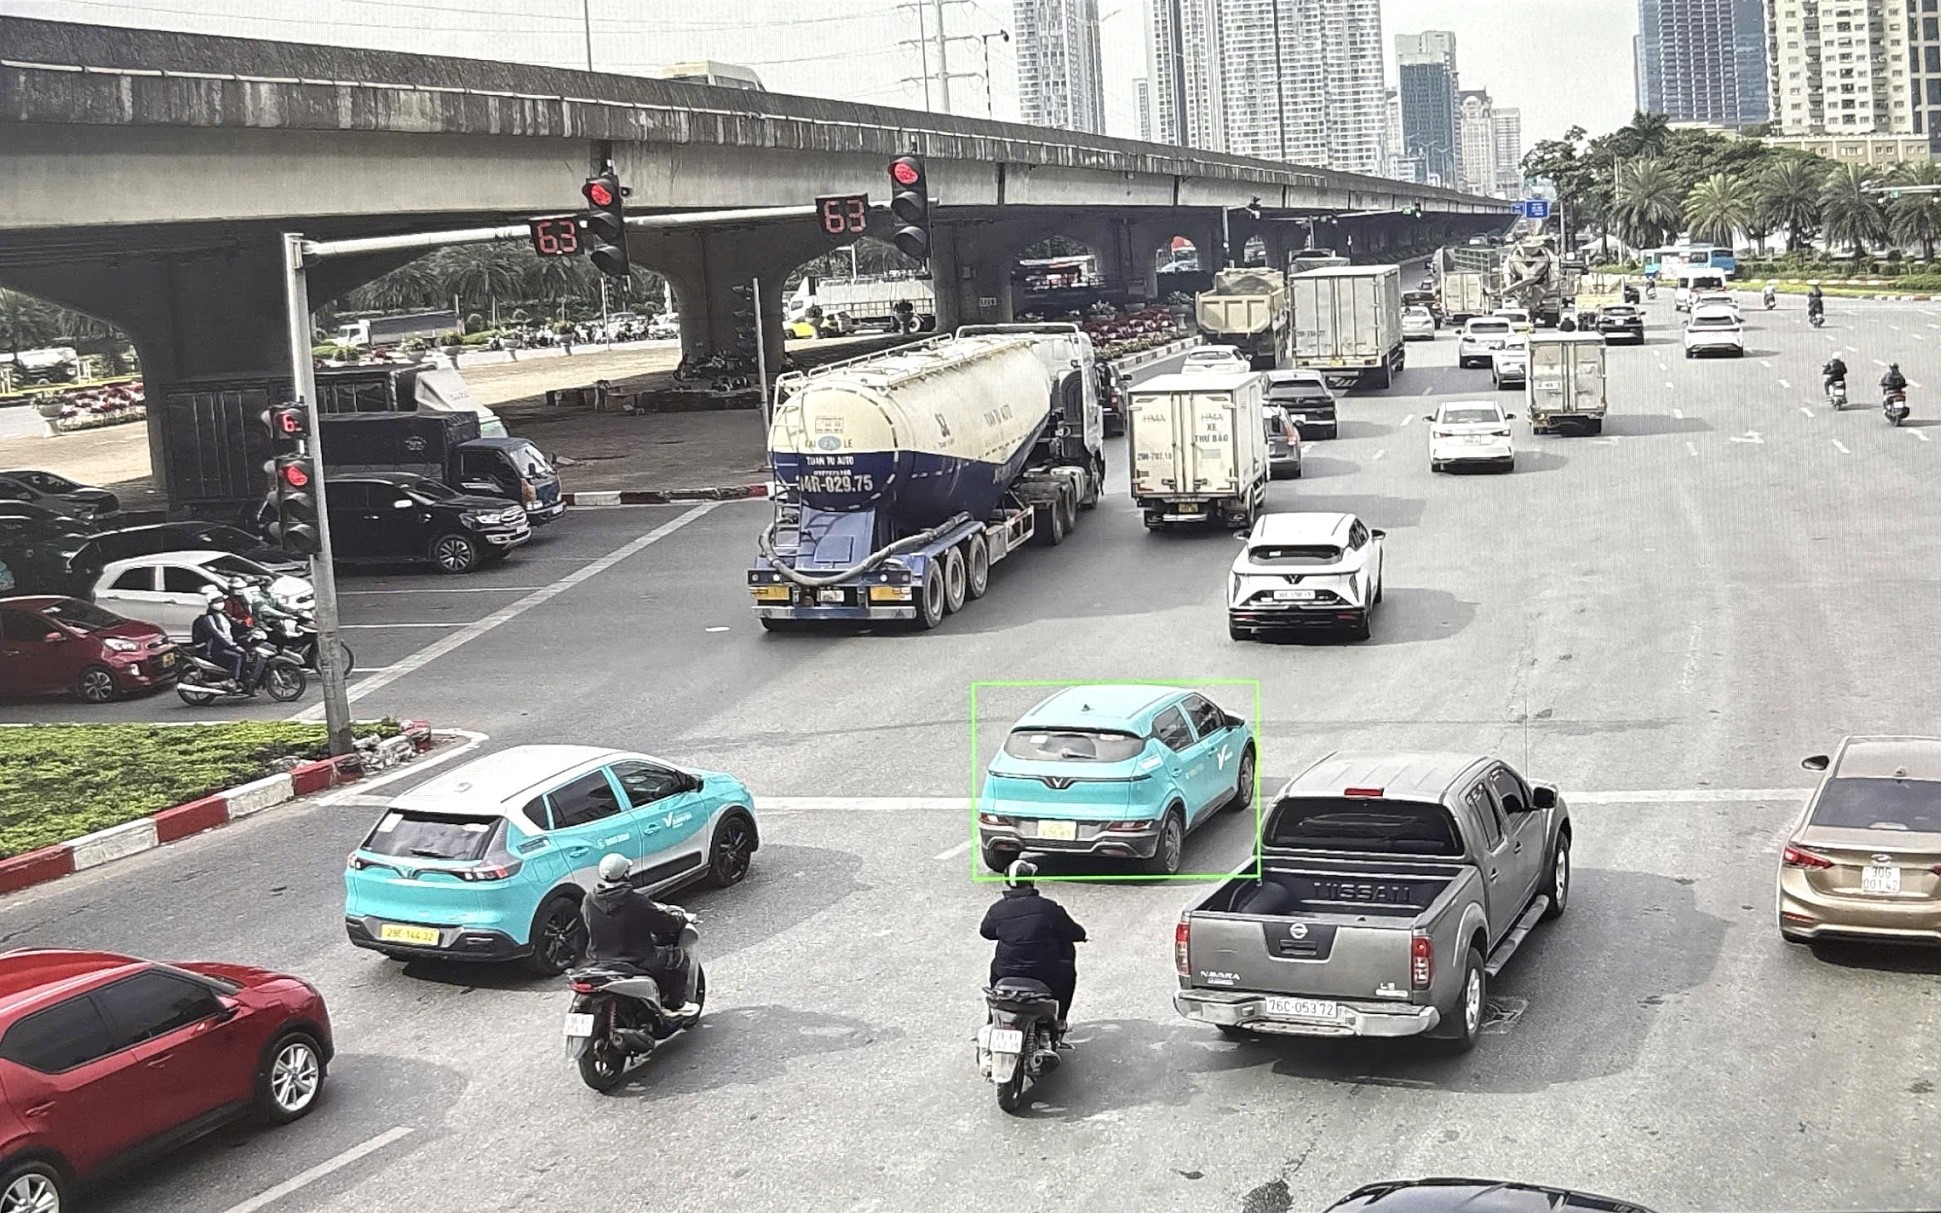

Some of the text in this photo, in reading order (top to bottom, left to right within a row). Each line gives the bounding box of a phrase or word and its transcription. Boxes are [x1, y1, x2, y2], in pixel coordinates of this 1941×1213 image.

[823, 199, 867, 233] 63
[537, 221, 578, 253] 63
[1206, 423, 1218, 431] XE
[837, 455, 855, 466] AUTO
